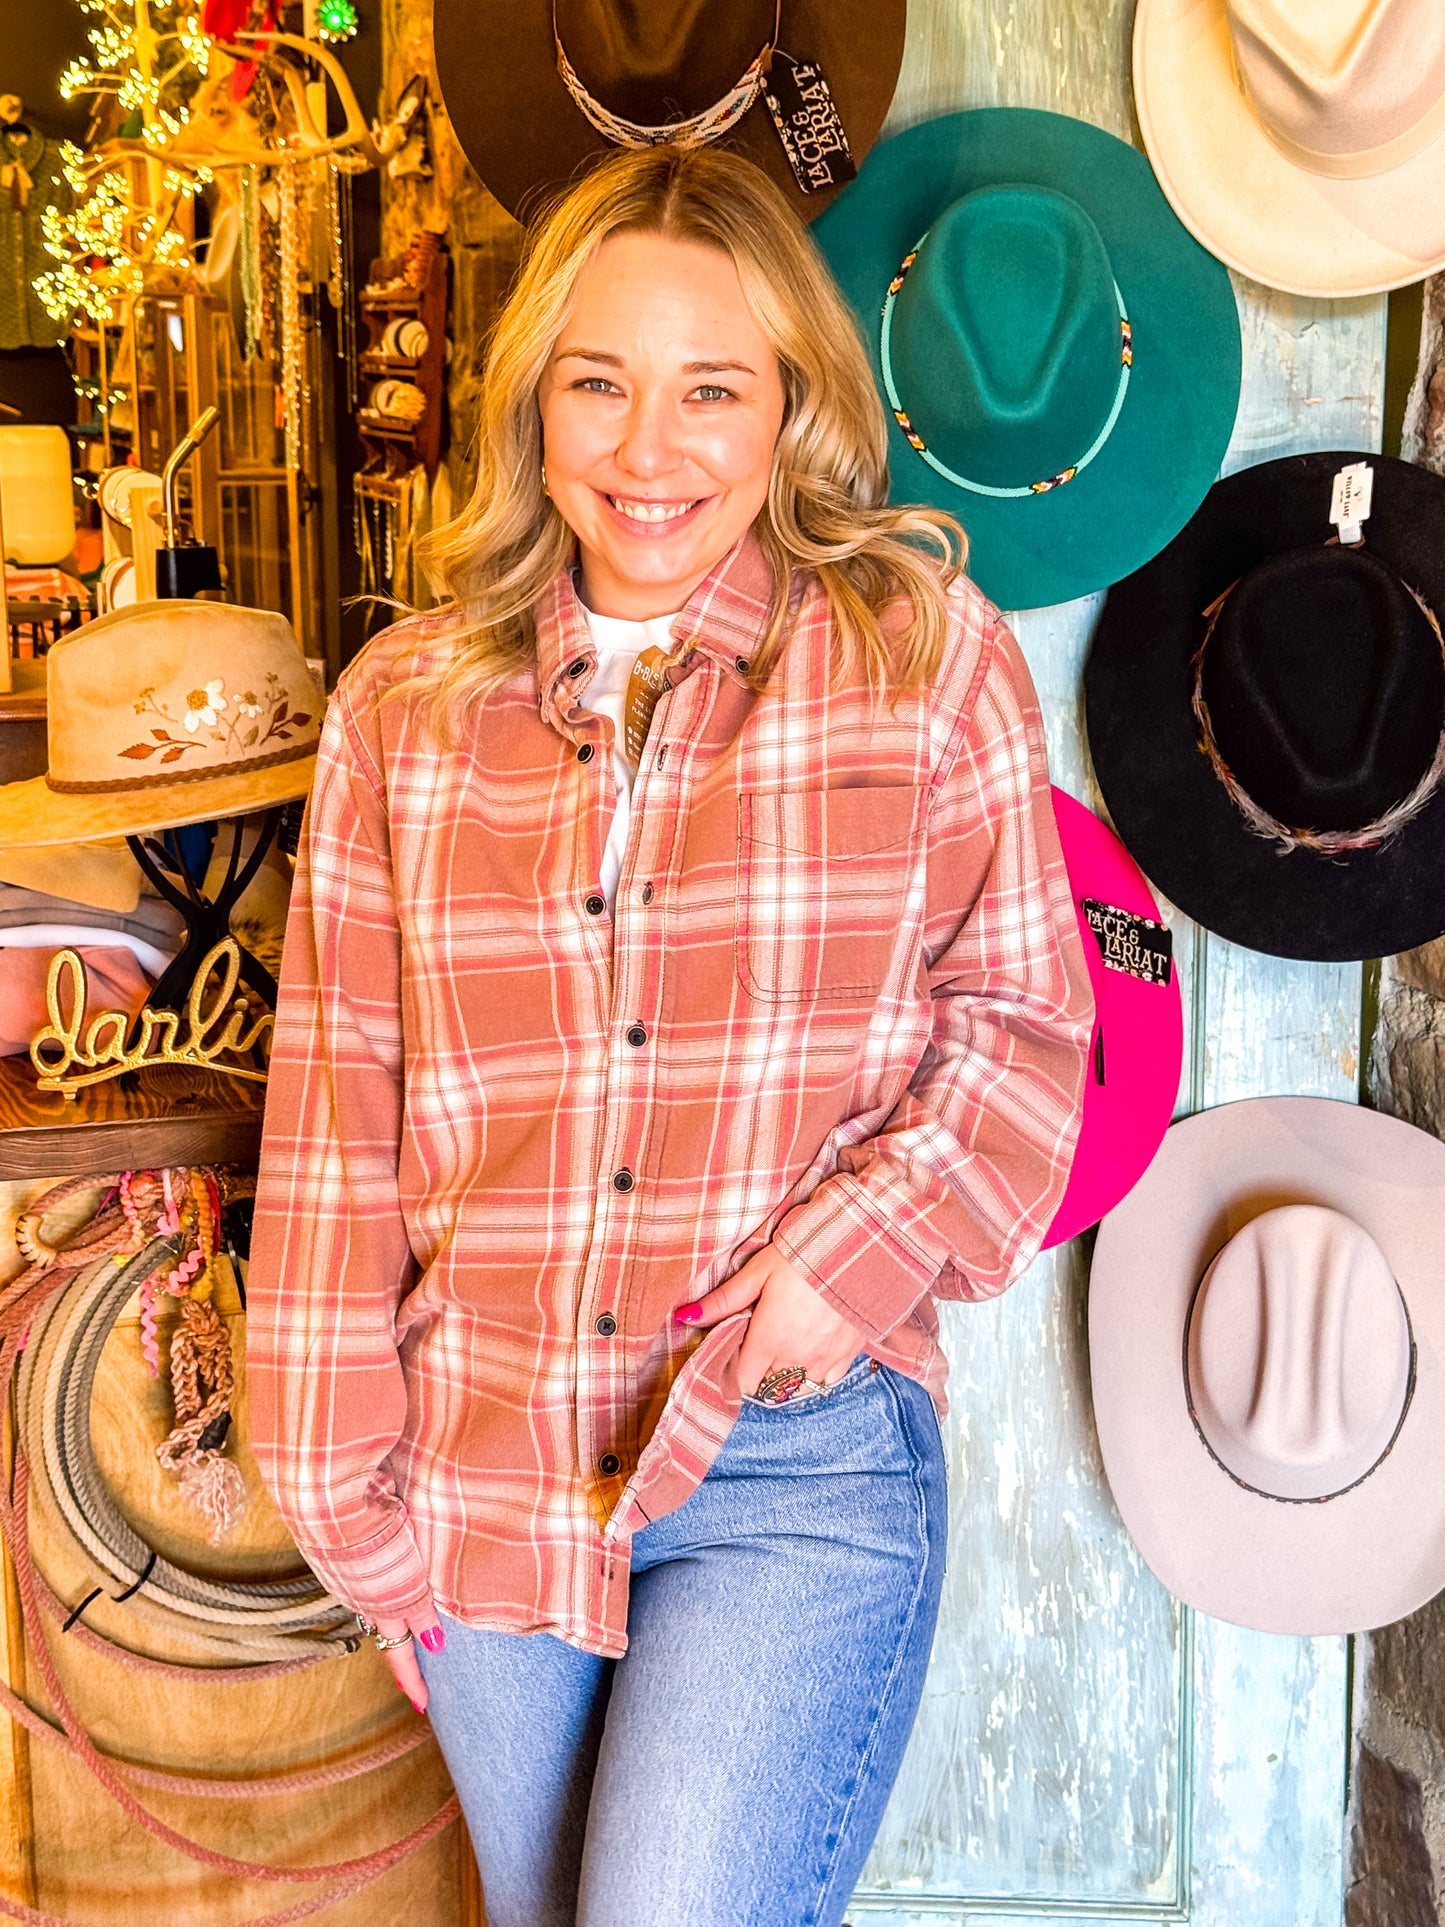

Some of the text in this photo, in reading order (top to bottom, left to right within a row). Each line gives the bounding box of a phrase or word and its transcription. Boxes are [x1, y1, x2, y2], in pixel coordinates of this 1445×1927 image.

[791, 65, 843, 155] LARIAT
[792, 111, 834, 189] LACE &
[1086, 908, 1139, 945] LACE &
[1104, 935, 1168, 976] LARIAT
